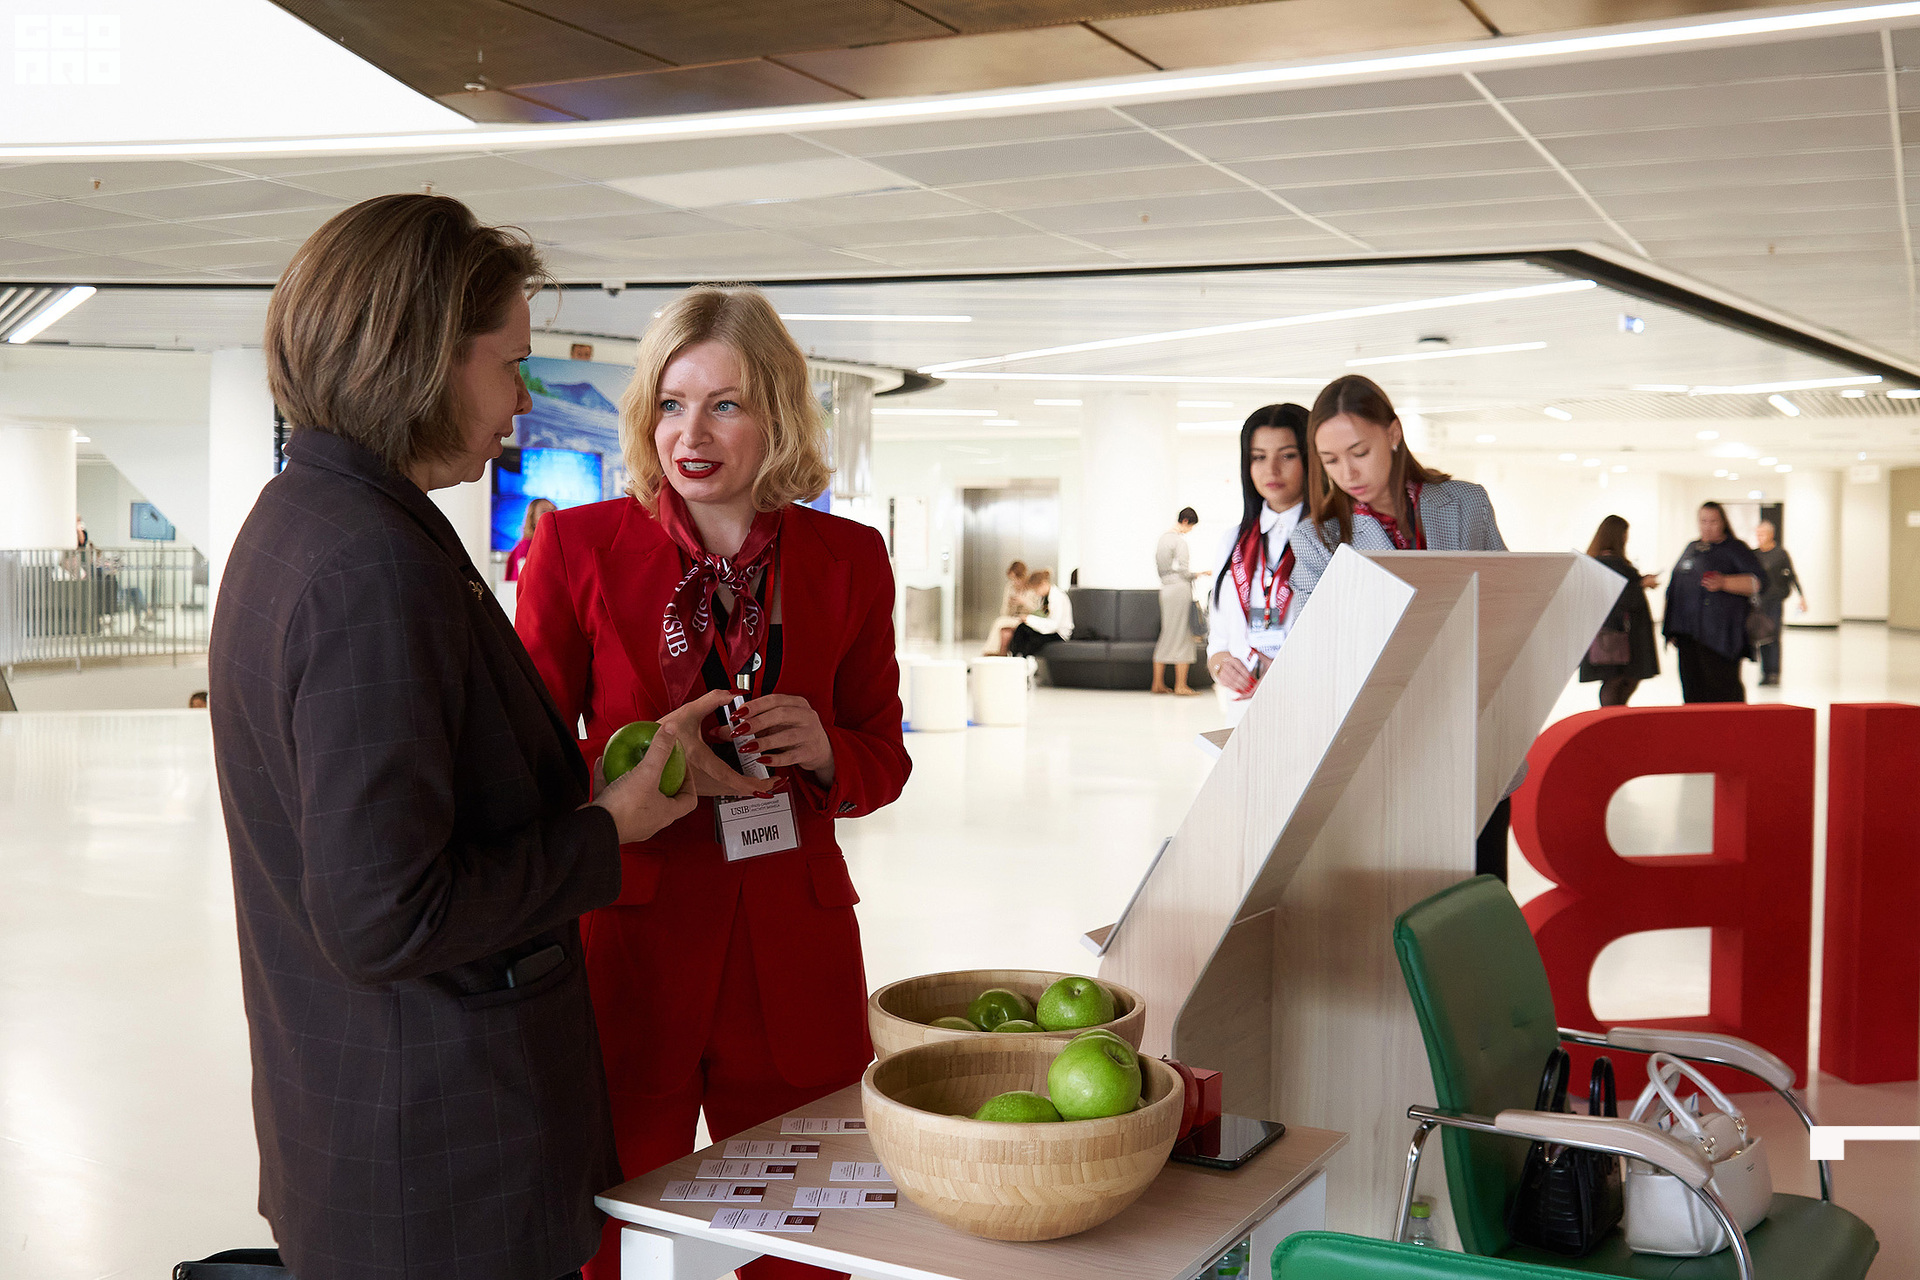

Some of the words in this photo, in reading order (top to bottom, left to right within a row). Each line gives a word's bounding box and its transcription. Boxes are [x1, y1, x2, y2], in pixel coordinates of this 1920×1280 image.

[662, 602, 689, 658] USIB
[731, 805, 749, 815] USIB
[741, 824, 779, 846] МАРИЯ
